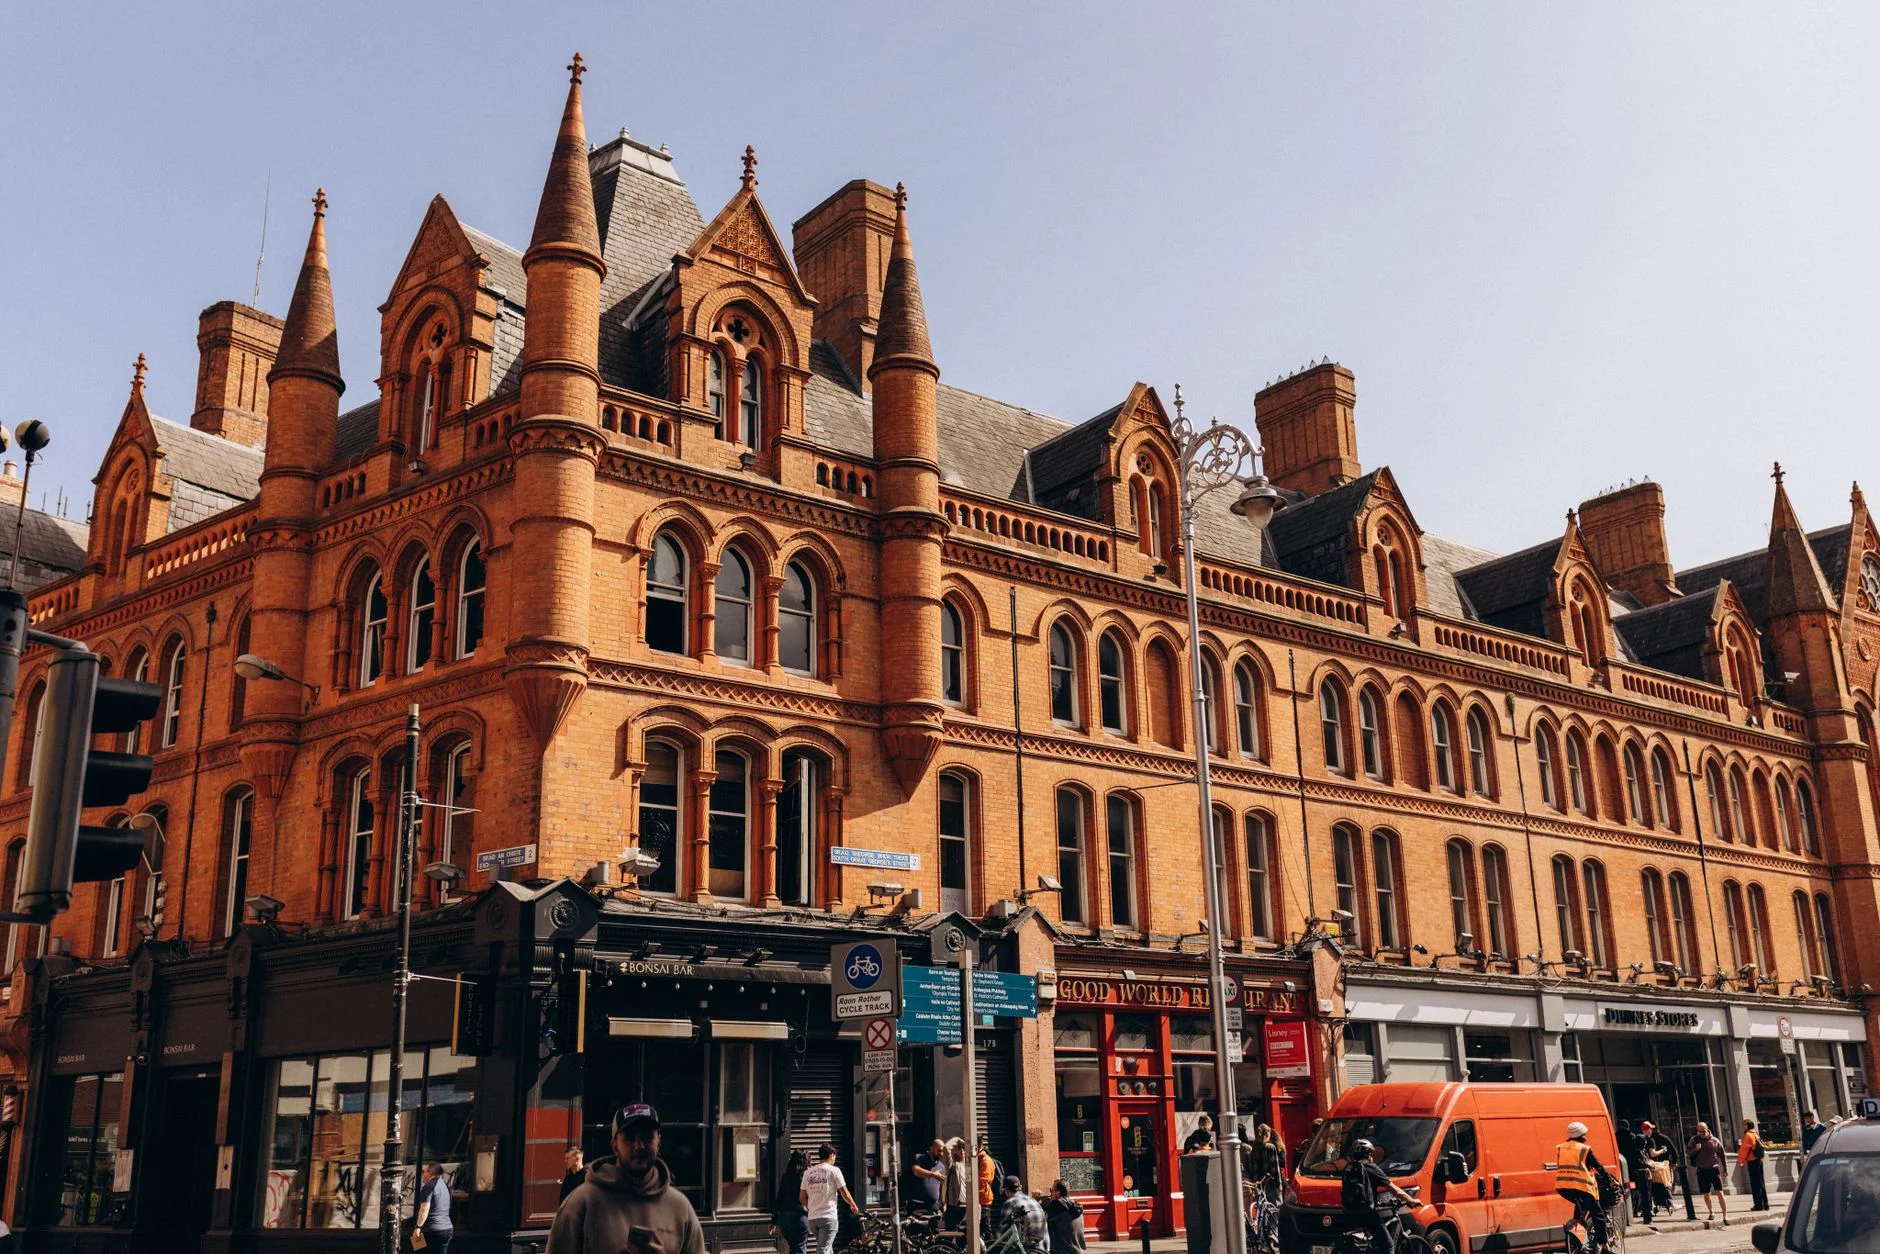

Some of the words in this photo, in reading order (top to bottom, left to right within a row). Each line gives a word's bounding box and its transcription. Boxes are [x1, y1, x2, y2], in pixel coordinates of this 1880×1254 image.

[528, 850, 534, 858] 2
[912, 857, 918, 866] 2
[629, 963, 670, 975] BONSAI
[673, 965, 694, 975] BAR
[1060, 980, 1111, 1001] GOOD
[1119, 983, 1183, 1004] WORLD
[858, 995, 882, 1003] Rothar
[465, 984, 474, 1034] RUSTIC
[840, 1005, 863, 1014] CYCLE
[865, 1003, 890, 1011] TRACK
[1604, 1008, 1654, 1025] DUNNES
[1655, 1010, 1698, 1027] STORES
[164, 1046, 183, 1055] BONSAI
[184, 1043, 196, 1052] BAR
[57, 1055, 74, 1064] BONSAI
[74, 1053, 86, 1062] BAR
